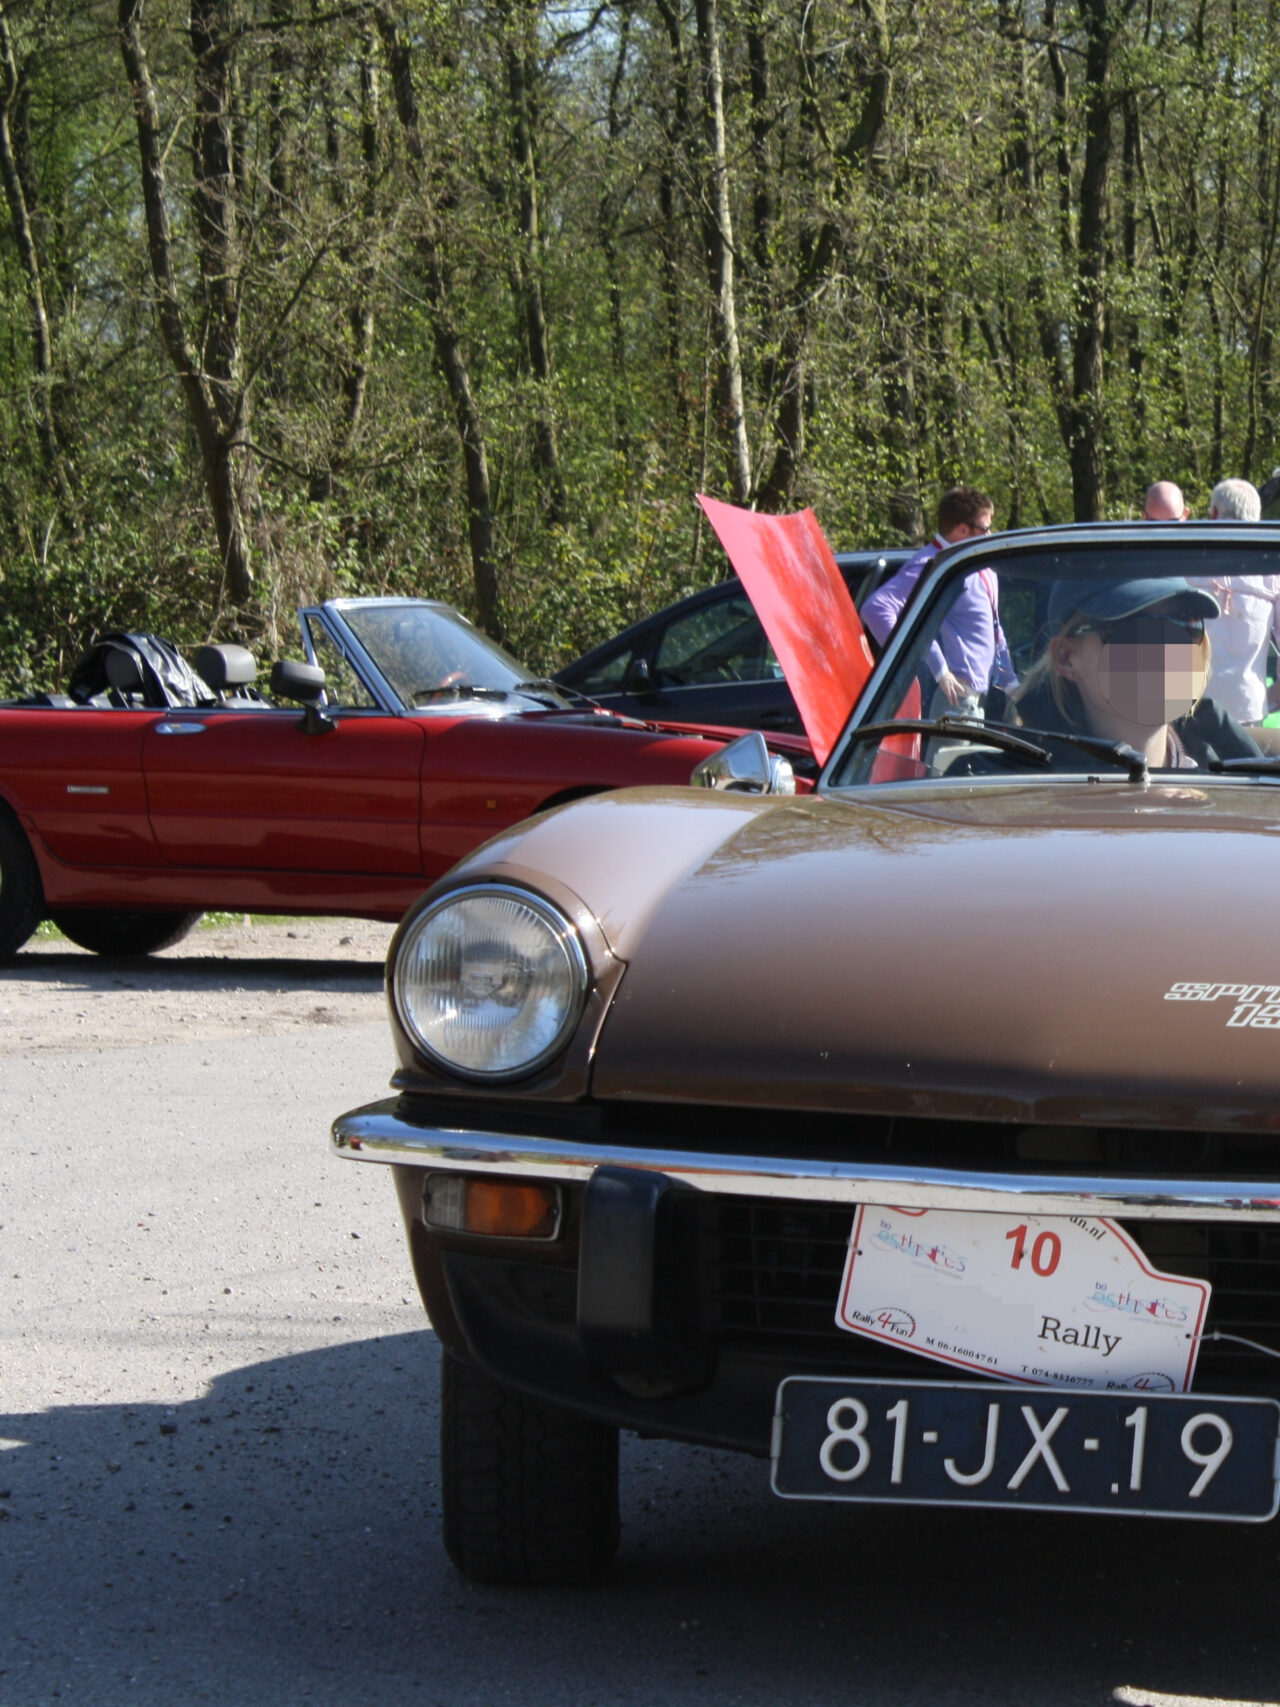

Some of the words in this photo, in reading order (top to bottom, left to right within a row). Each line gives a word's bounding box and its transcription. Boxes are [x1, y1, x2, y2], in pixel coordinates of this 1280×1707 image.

[1005, 1223, 1062, 1278] 10
[877, 1311, 893, 1329] 4
[1037, 1315, 1123, 1357] Rally
